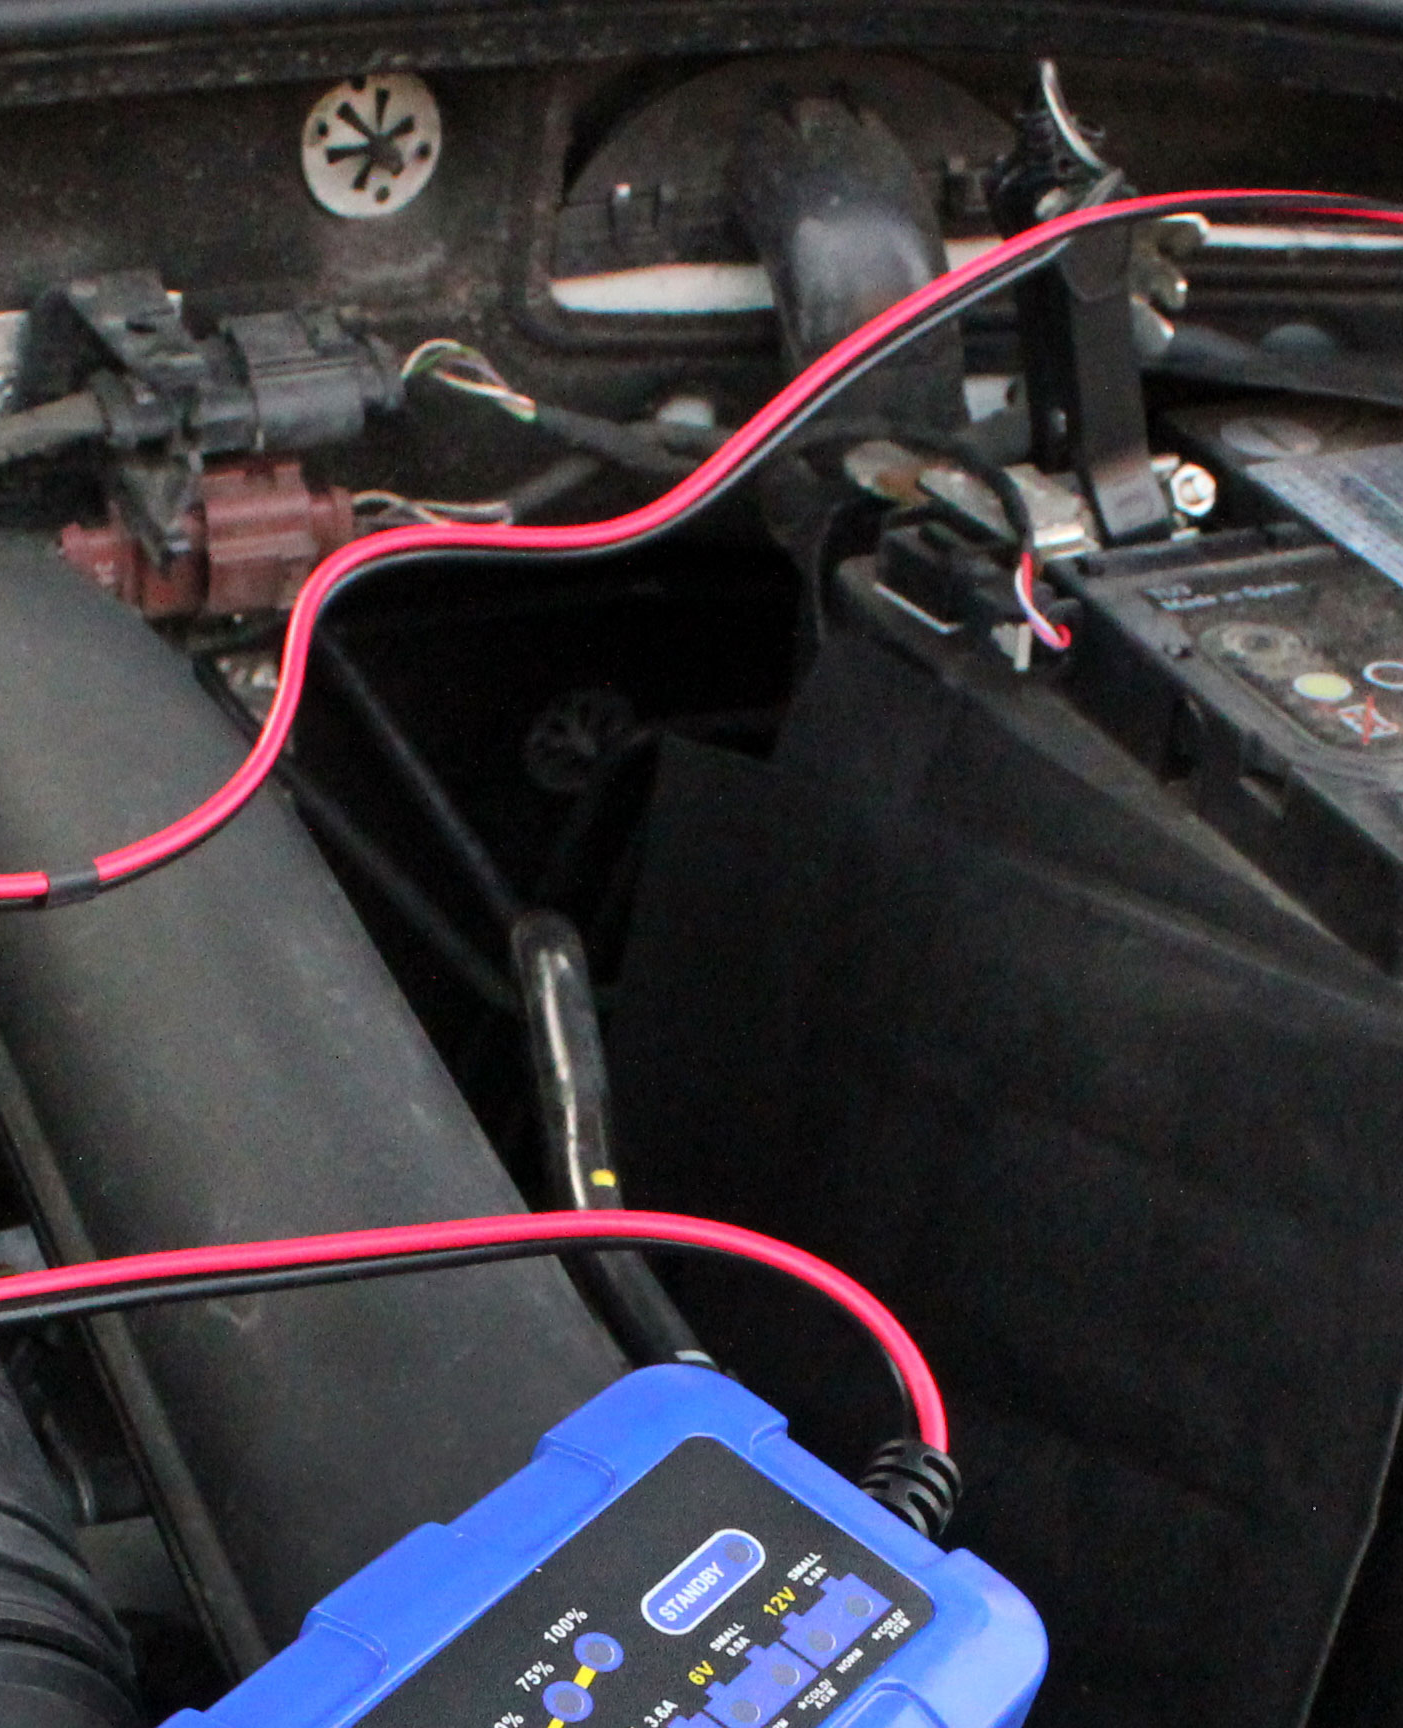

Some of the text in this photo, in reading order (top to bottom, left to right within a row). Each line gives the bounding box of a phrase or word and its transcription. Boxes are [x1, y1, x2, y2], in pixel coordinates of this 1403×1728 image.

[787, 1552, 822, 1581] SMALL
[658, 1561, 726, 1622] STANDBY
[762, 1586, 797, 1616] 12V
[543, 1607, 589, 1645] 100%
[709, 1622, 745, 1652] SMALL
[687, 1660, 716, 1686] 6V
[836, 1648, 864, 1674] NORM
[514, 1660, 556, 1693] 75%
[644, 1699, 679, 1728] 3.6A
